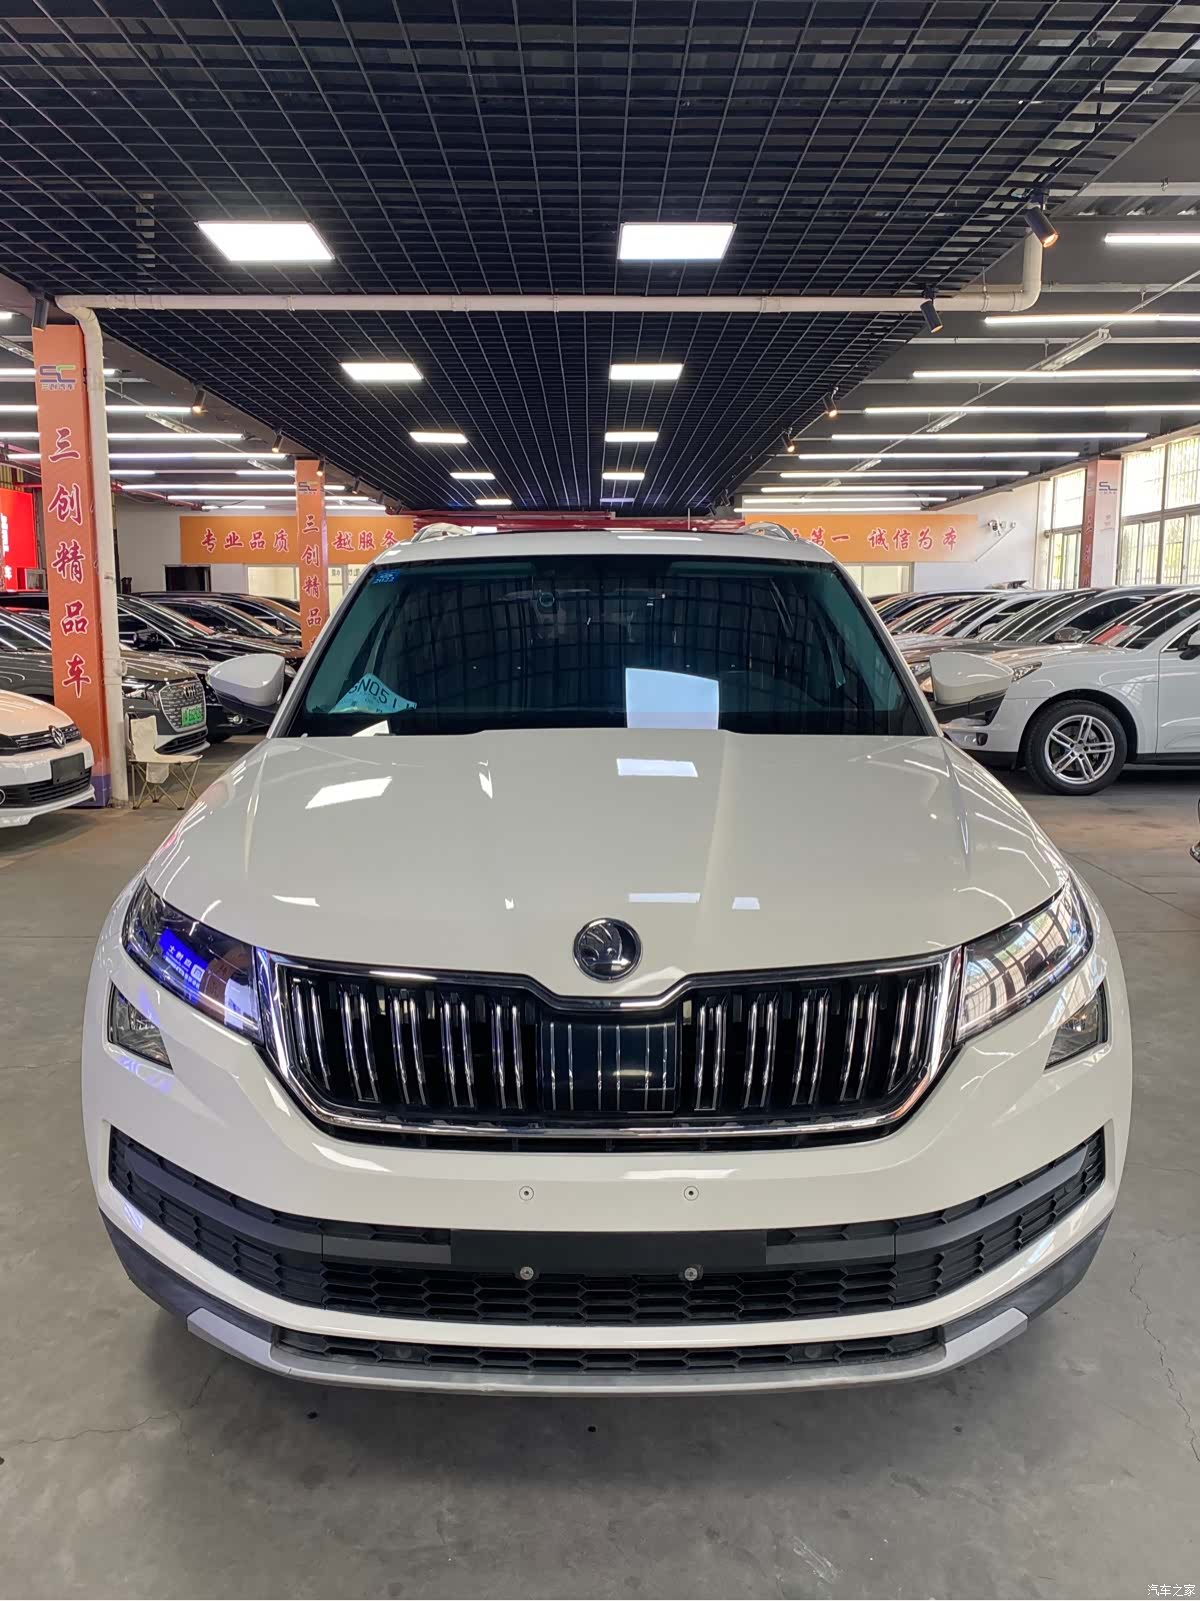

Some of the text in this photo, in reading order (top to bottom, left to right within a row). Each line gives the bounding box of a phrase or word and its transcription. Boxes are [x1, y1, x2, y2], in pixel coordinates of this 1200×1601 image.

[48, 426, 91, 698] 三创精品车
[201, 528, 288, 553] 专业品质
[868, 527, 957, 550] 诚信为本
[301, 514, 323, 644] 三创精品
